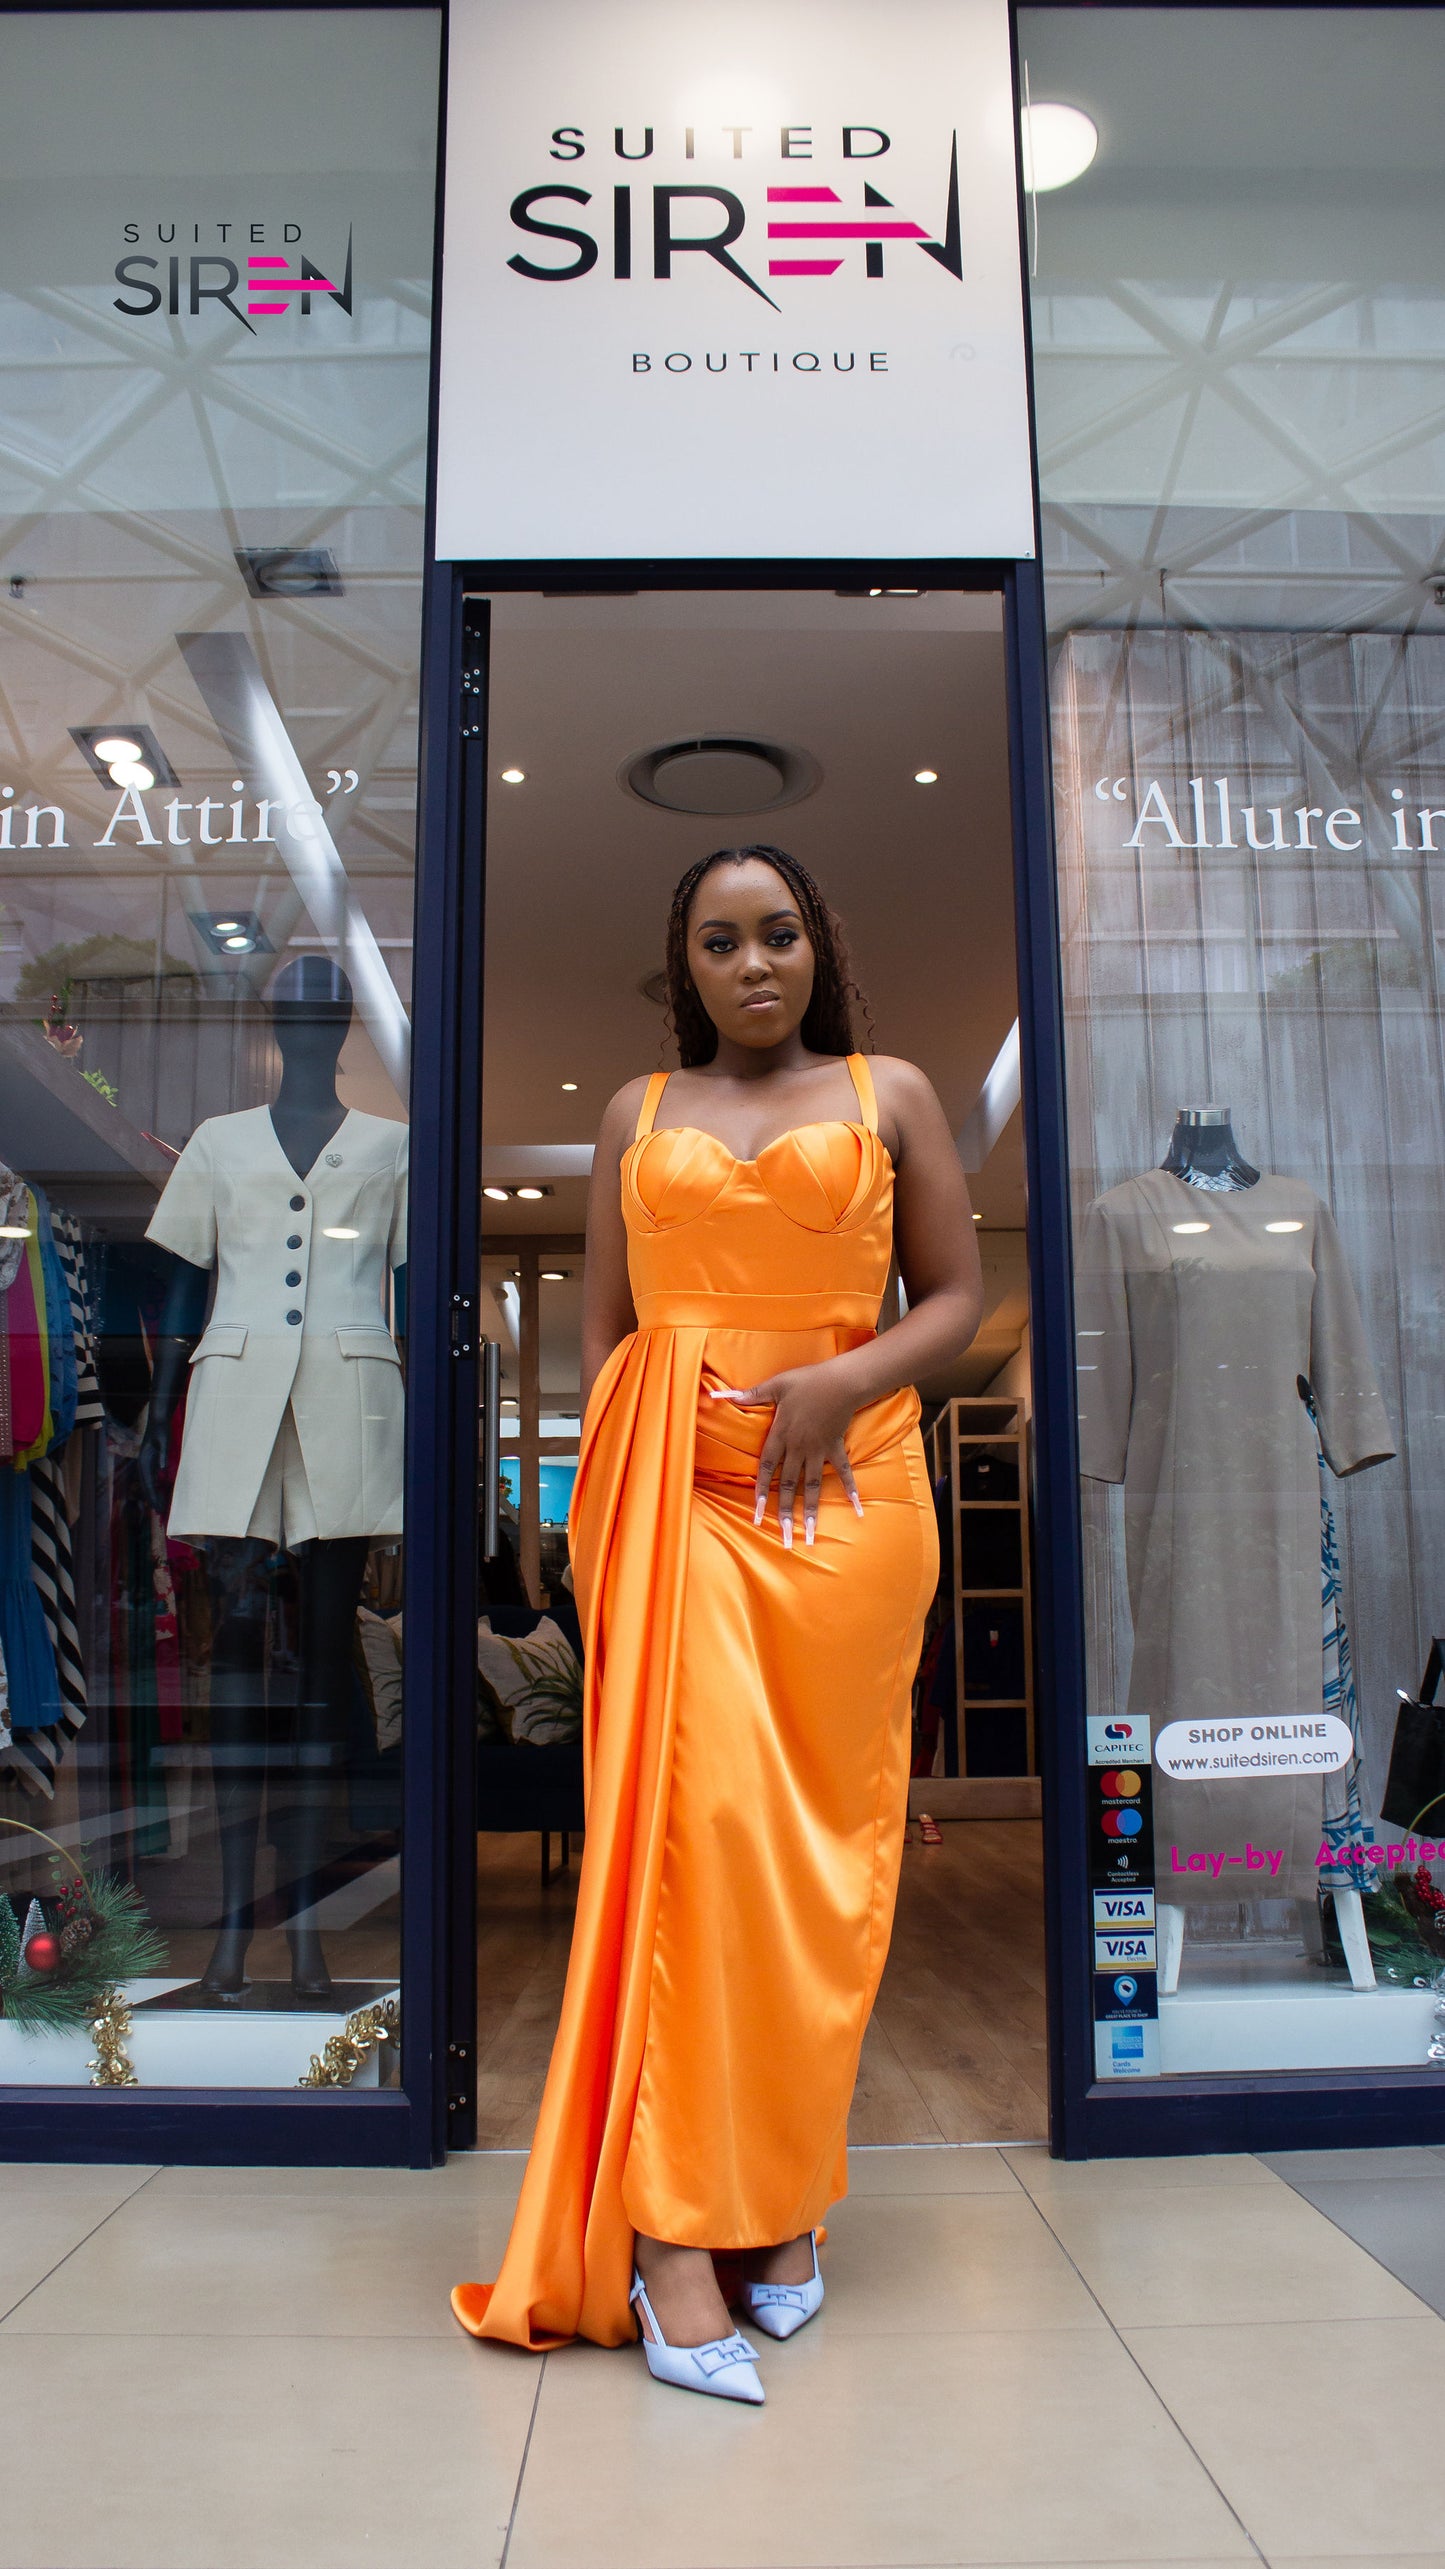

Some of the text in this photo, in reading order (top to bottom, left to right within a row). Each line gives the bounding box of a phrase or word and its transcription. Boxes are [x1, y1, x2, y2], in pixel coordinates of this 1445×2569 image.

[549, 126, 891, 161] SUITED
[506, 128, 964, 313] SIREN
[123, 223, 303, 244] SUITED
[113, 221, 353, 337] SIREN
[633, 351, 889, 374] BOUTIQUE
[0, 786, 70, 849] in
[1095, 777, 1362, 851] “Allure
[1188, 1723, 1327, 1744] SHOP ONLINE
[1094, 1743, 1144, 1753] CAPITEC
[1168, 1751, 1339, 1771] www.suitedsiren.com
[1171, 1843, 1285, 1878] Lay-by
[1101, 1900, 1146, 1917] VISA
[1102, 1940, 1147, 1956] VISA
